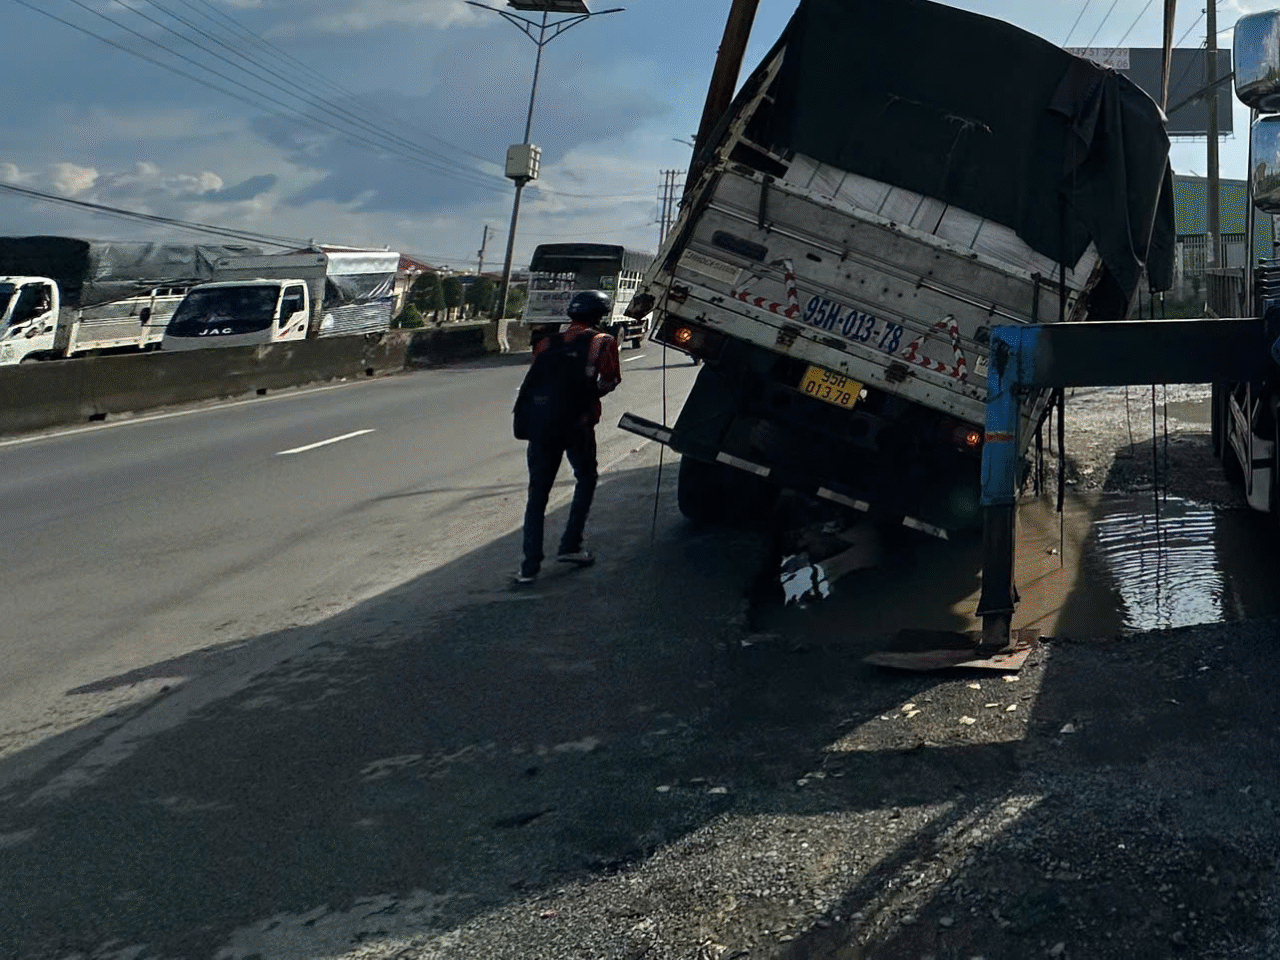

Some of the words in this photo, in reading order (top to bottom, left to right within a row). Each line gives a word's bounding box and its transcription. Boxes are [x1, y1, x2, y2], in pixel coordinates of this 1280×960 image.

[198, 327, 232, 336] JAC
[803, 295, 904, 354] 95H-013-78
[821, 370, 848, 388] 95H
